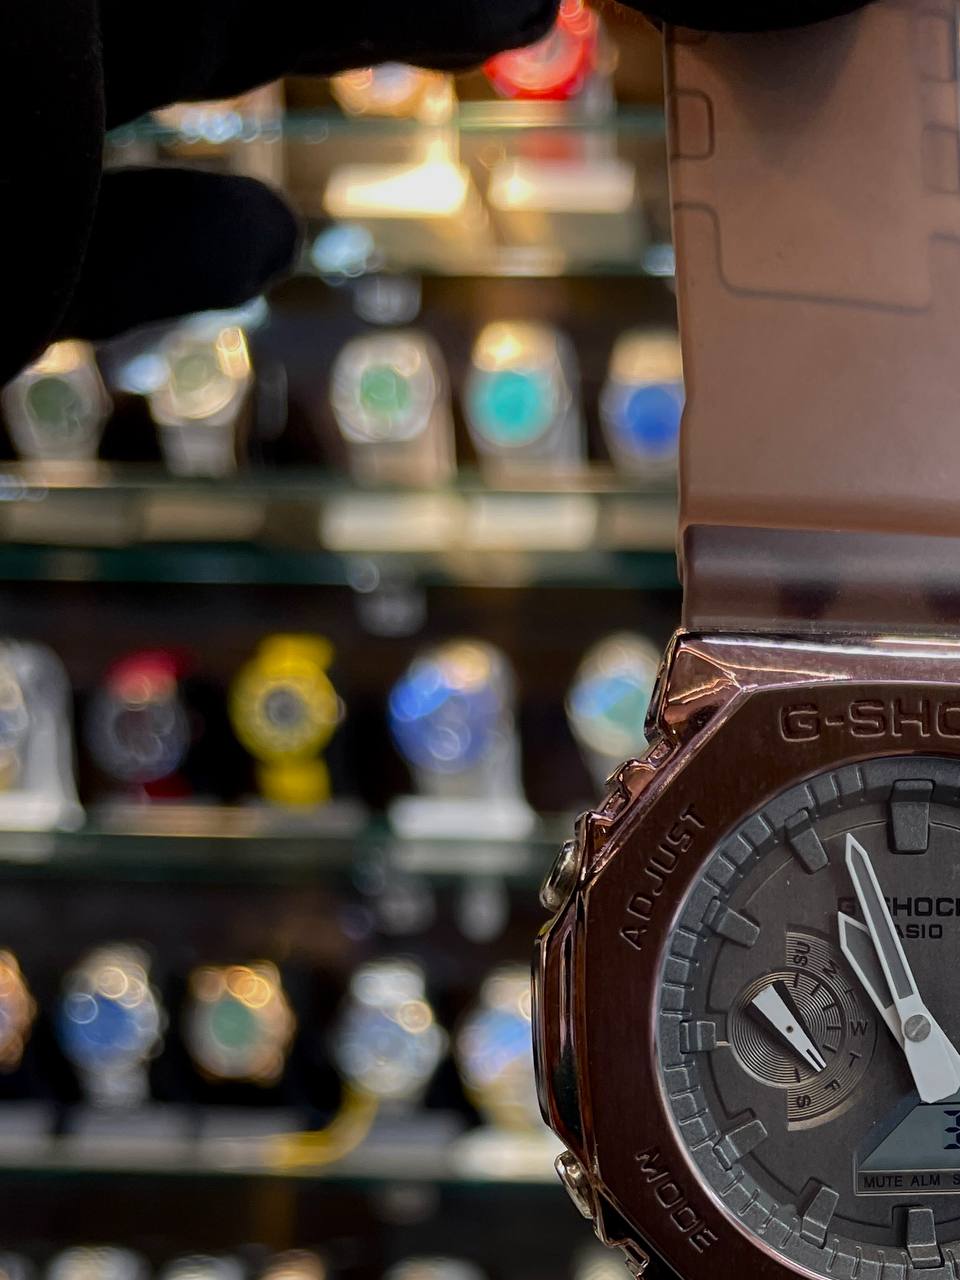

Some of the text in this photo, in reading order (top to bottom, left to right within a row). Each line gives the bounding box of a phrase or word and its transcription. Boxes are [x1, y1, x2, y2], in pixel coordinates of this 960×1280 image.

[619, 803, 704, 950] ADJUST
[850, 1021, 869, 1036] W
[849, 1052, 862, 1068] T
[796, 1095, 812, 1108] S
[864, 1175, 903, 1188] MUTE
[910, 1174, 940, 1187] ALM
[635, 1151, 718, 1253] MODE
